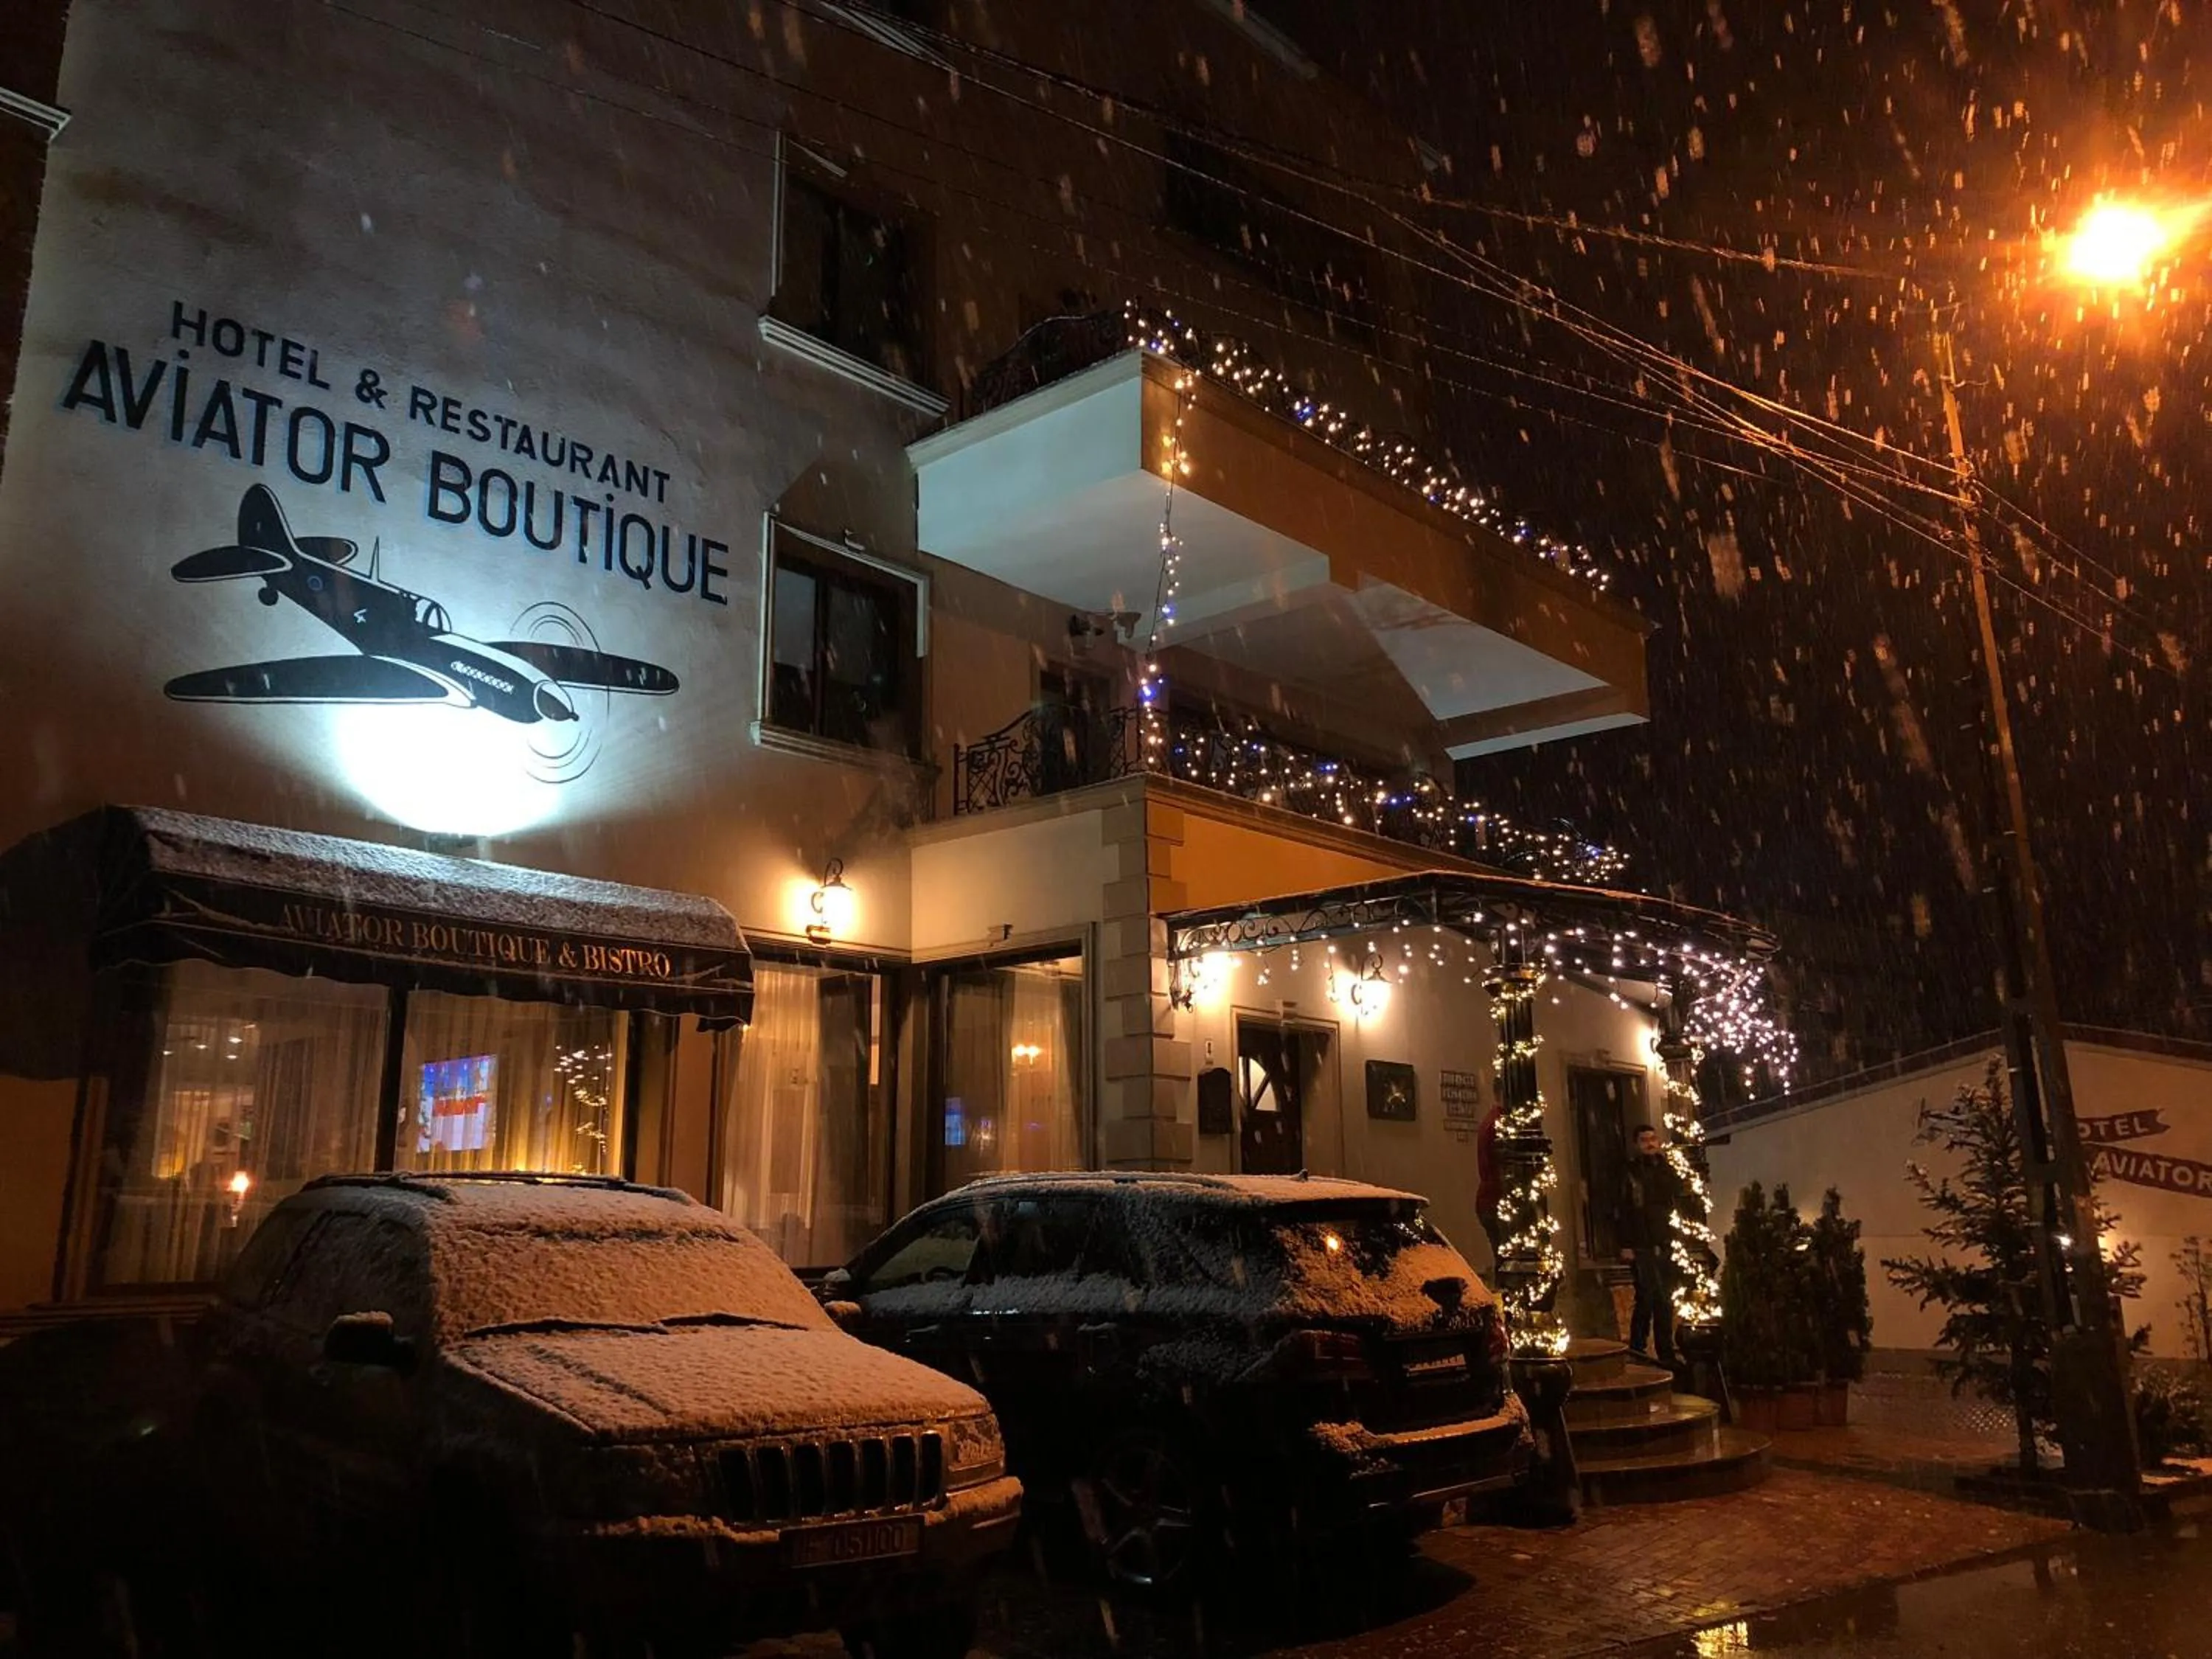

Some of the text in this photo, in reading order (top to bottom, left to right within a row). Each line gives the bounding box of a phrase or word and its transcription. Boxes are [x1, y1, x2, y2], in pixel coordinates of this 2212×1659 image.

[171, 300, 671, 504] HOTEL & RESTAURANT
[282, 903, 671, 979] AVIATOR BOUTIQUE & BISTRO
[2077, 1116, 2149, 1138] OTEL
[2091, 1150, 2212, 1192] AVIATOR
